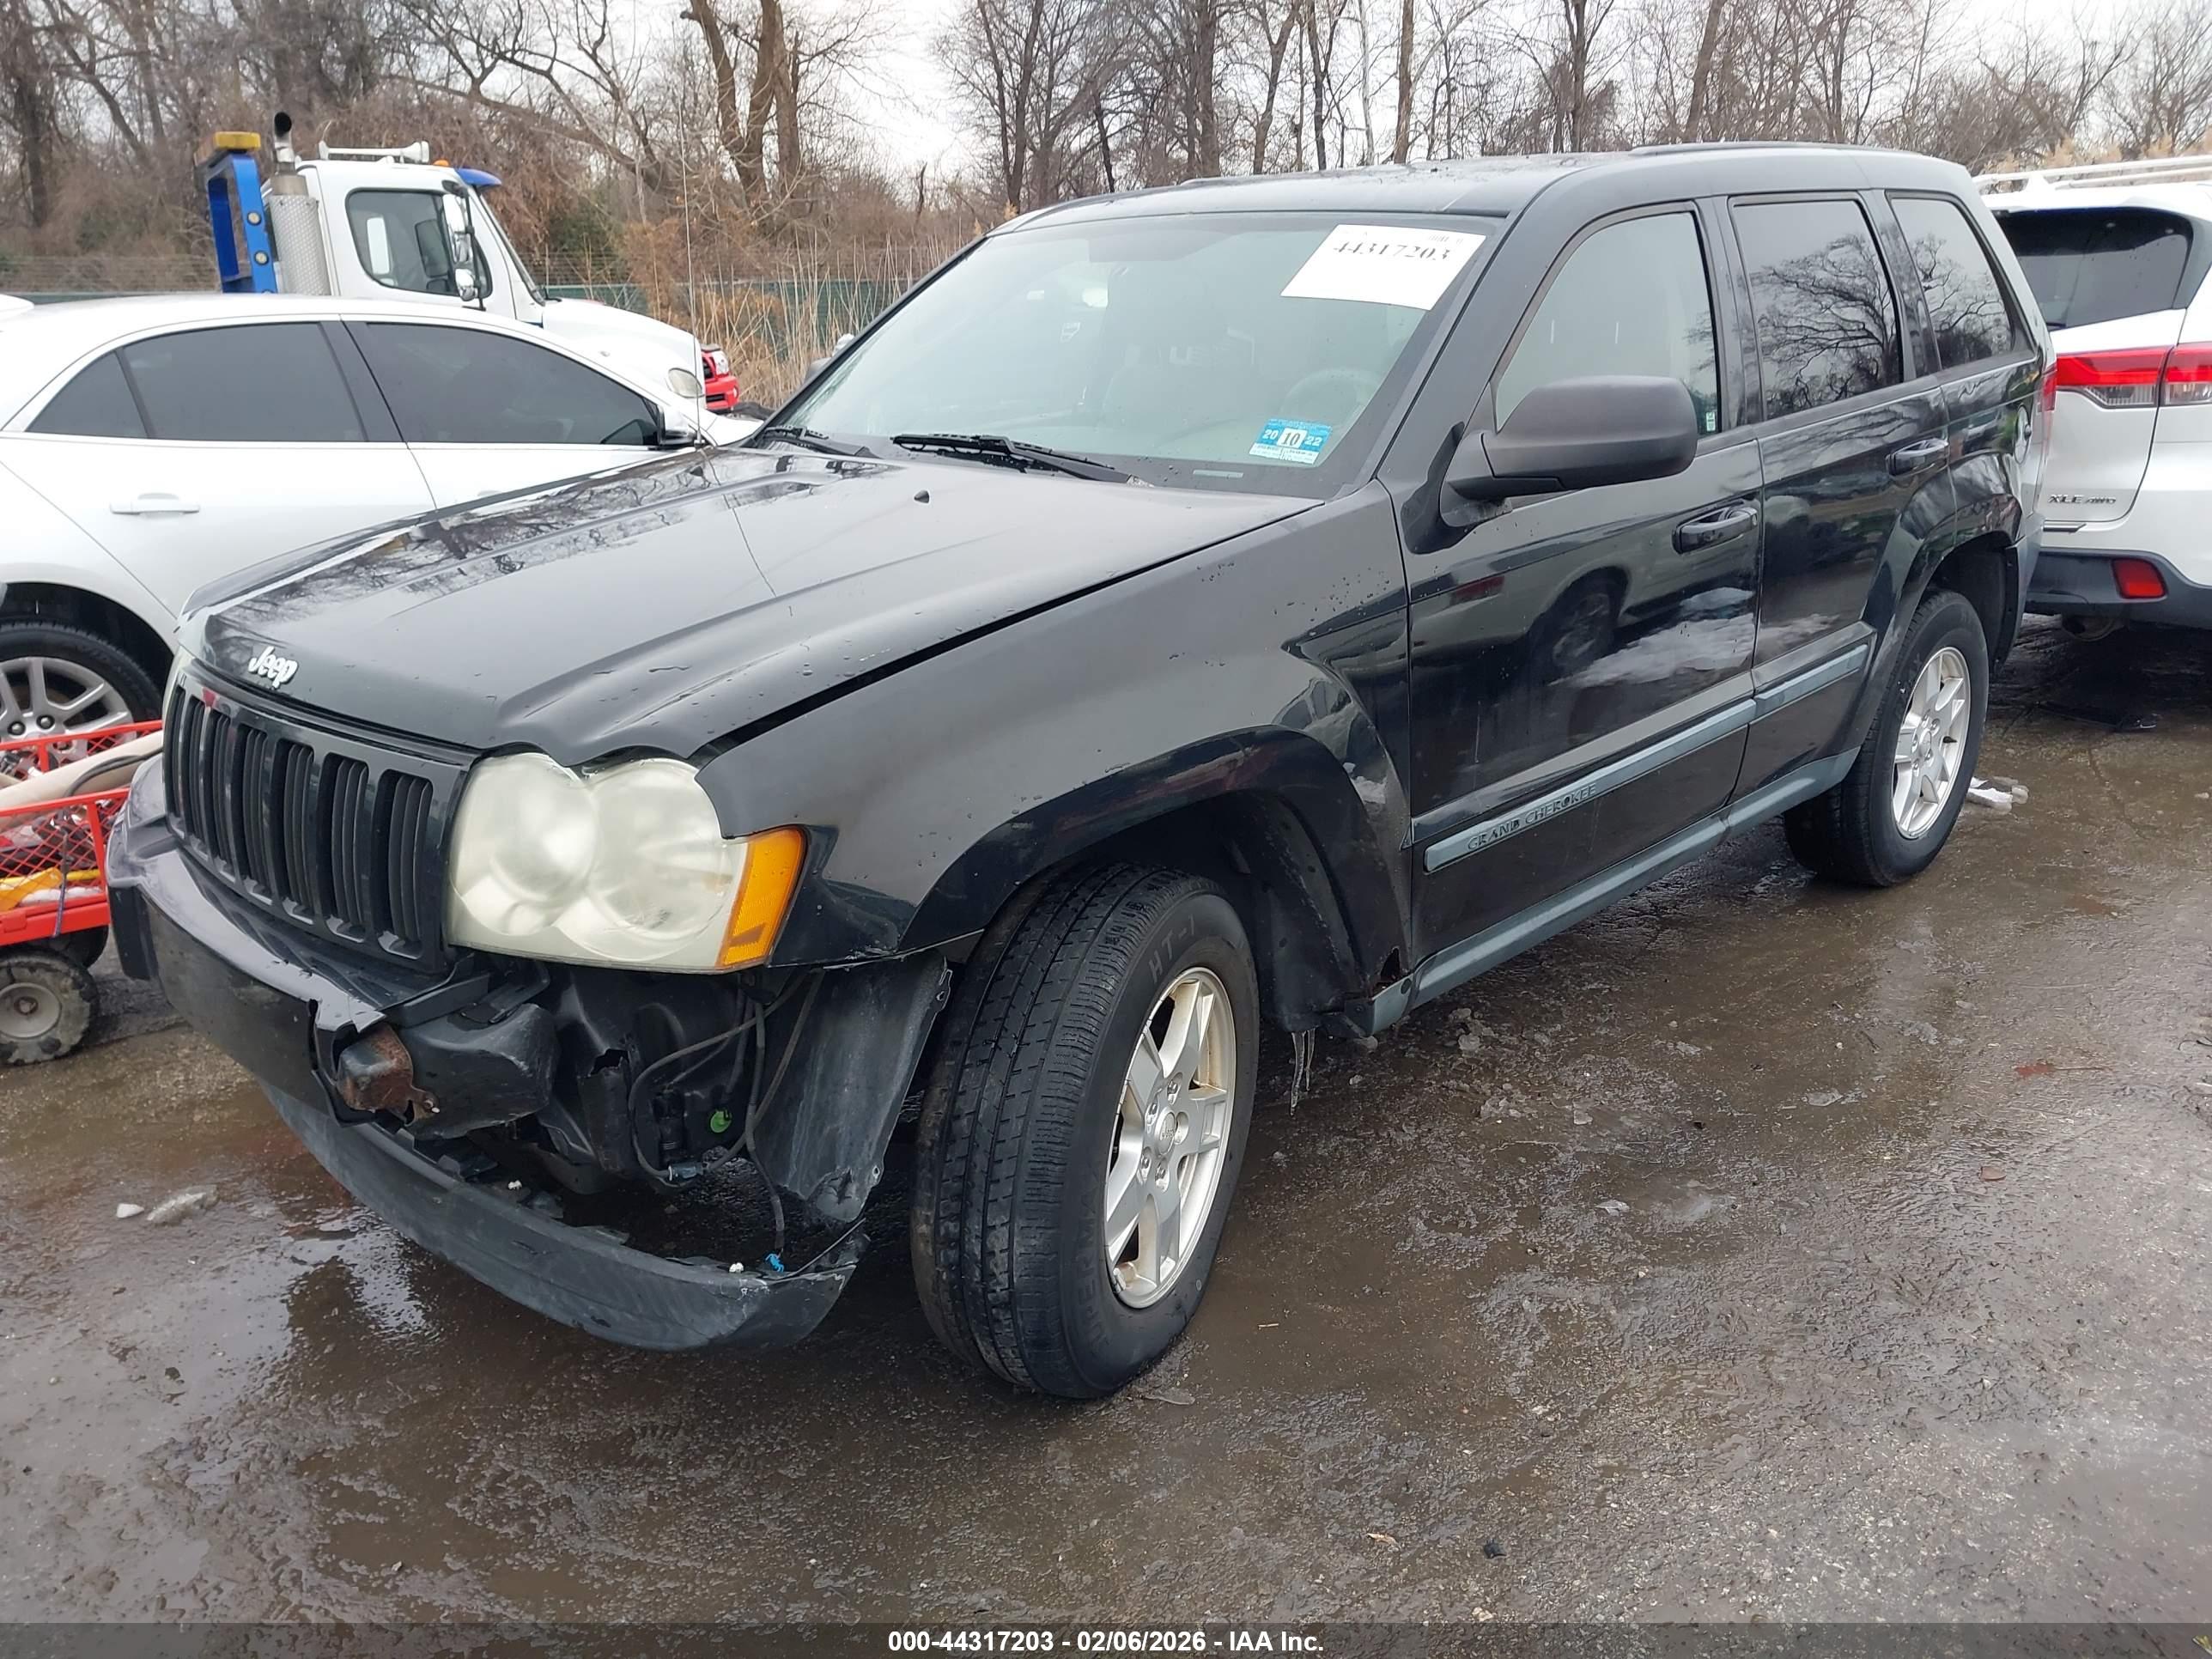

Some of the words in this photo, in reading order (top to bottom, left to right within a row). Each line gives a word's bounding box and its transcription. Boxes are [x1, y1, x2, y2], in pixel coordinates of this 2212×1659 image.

[1334, 240, 1452, 261] 44317203
[1262, 428, 1279, 441] 20
[1281, 431, 1301, 447] 10
[1304, 435, 1323, 447] 22
[2048, 494, 2084, 505] XLE
[247, 645, 299, 690] Jeep
[1468, 816, 1521, 851] GRAND
[1524, 781, 1598, 825] CHEROKEE
[1148, 913, 1194, 984] HT-1
